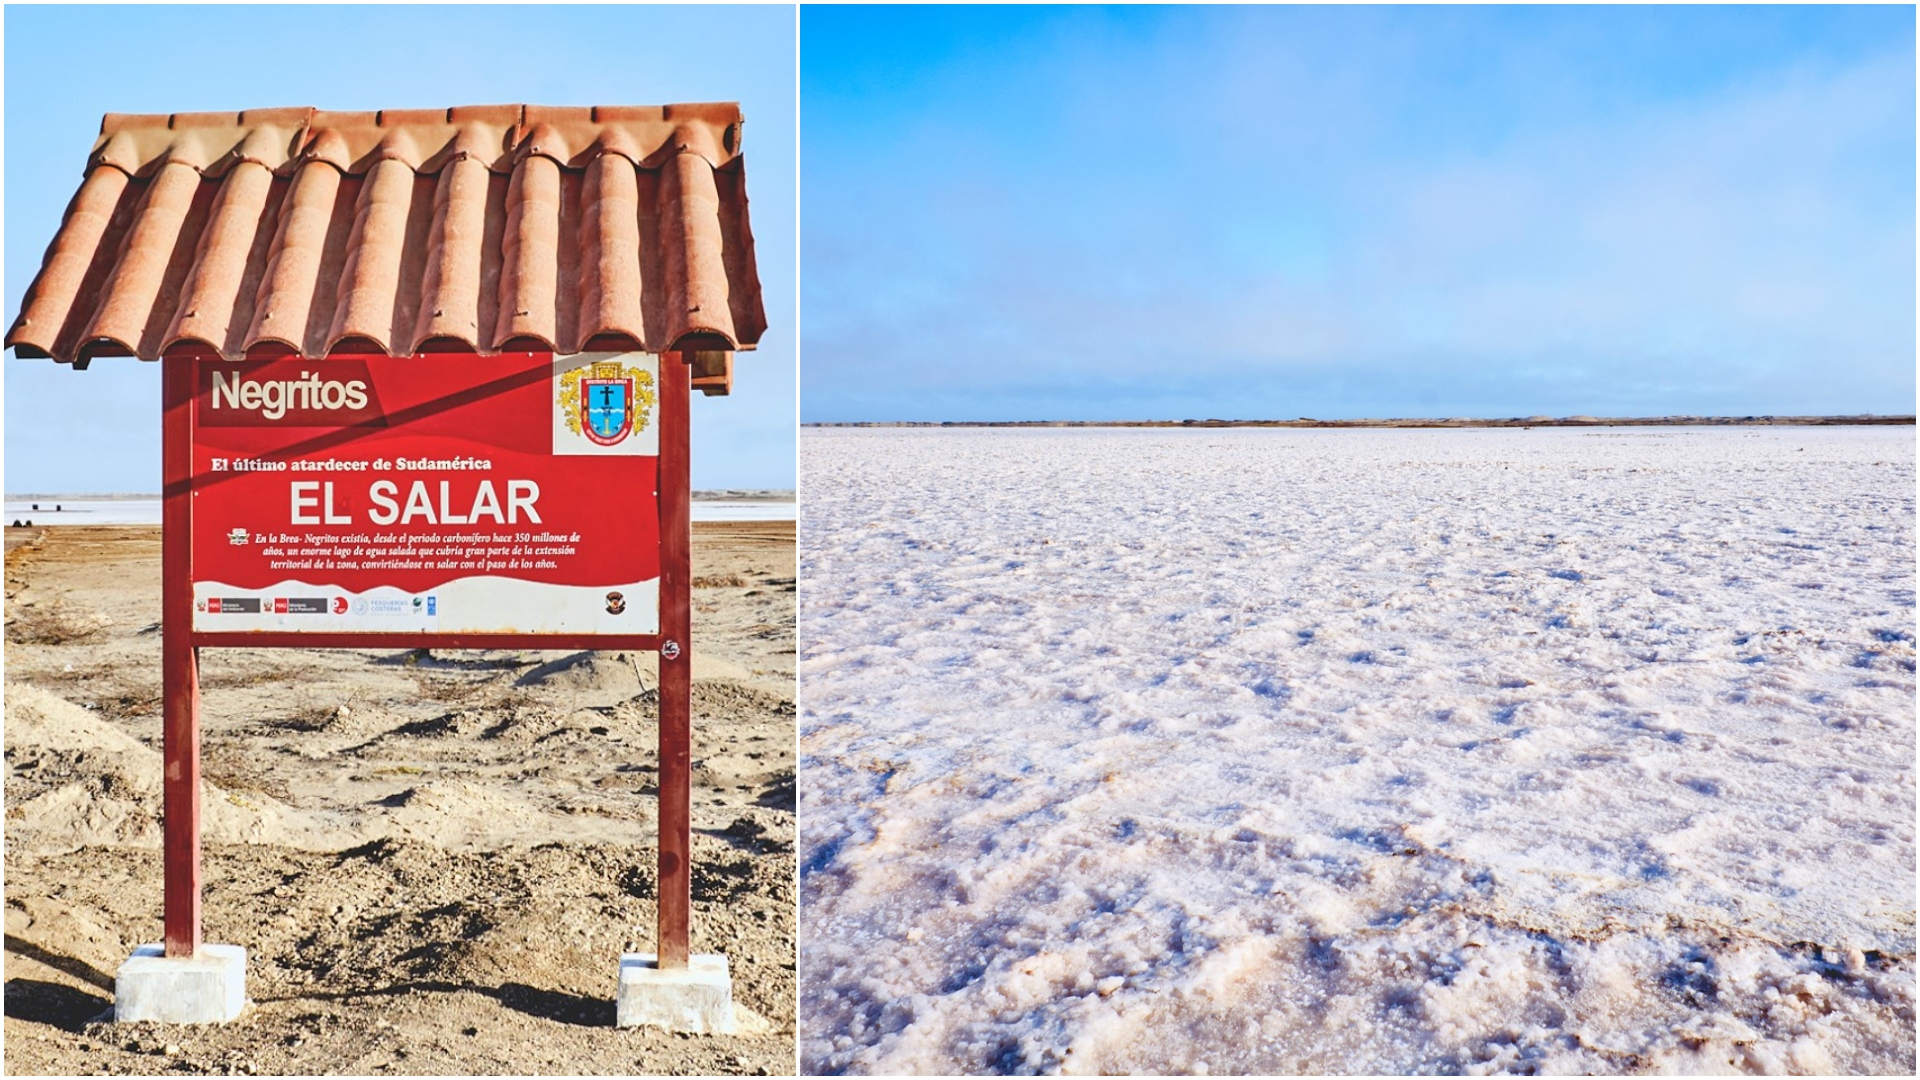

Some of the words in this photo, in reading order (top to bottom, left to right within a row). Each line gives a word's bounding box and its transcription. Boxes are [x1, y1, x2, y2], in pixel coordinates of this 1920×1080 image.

[211, 370, 368, 420] Negritos
[211, 457, 229, 471] El
[233, 456, 288, 472] último
[291, 457, 369, 472] atardecer
[373, 457, 393, 471] de
[396, 455, 492, 471] Sudamérica
[290, 481, 353, 526] EL
[368, 479, 543, 526] SALAR
[255, 533, 267, 544] En
[269, 533, 278, 544] la
[280, 533, 302, 544] Brea-
[305, 533, 340, 547] Negritos
[341, 533, 371, 545] existía,
[374, 533, 398, 544] desde
[399, 533, 407, 544] el
[408, 533, 441, 547] periodo
[443, 533, 491, 547] carbonífero
[493, 533, 513, 543] hace
[515, 533, 531, 543] 350
[532, 532, 568, 543] millones
[569, 532, 581, 543] de
[262, 546, 285, 557] años,
[287, 548, 299, 556] un
[300, 548, 332, 556] enorme
[334, 546, 352, 558] lago
[354, 546, 365, 556] de
[366, 548, 387, 558] agua
[388, 546, 417, 556] salada
[418, 548, 435, 558] que
[436, 545, 464, 556] cubría
[465, 548, 486, 559] gran
[487, 546, 511, 559] parte
[512, 545, 523, 556] de
[524, 545, 534, 556] la
[535, 545, 576, 556] extensión
[271, 559, 313, 570] territorial
[314, 559, 325, 570] de
[326, 559, 335, 569] la
[337, 561, 360, 571] zona,
[362, 559, 423, 570] convirtiéndose
[424, 561, 435, 569] en
[437, 559, 459, 569] salar
[460, 561, 475, 569] con
[477, 558, 486, 569] el
[487, 561, 507, 572] paso
[509, 559, 520, 569] de
[521, 558, 534, 569] los
[535, 558, 558, 569] años.
